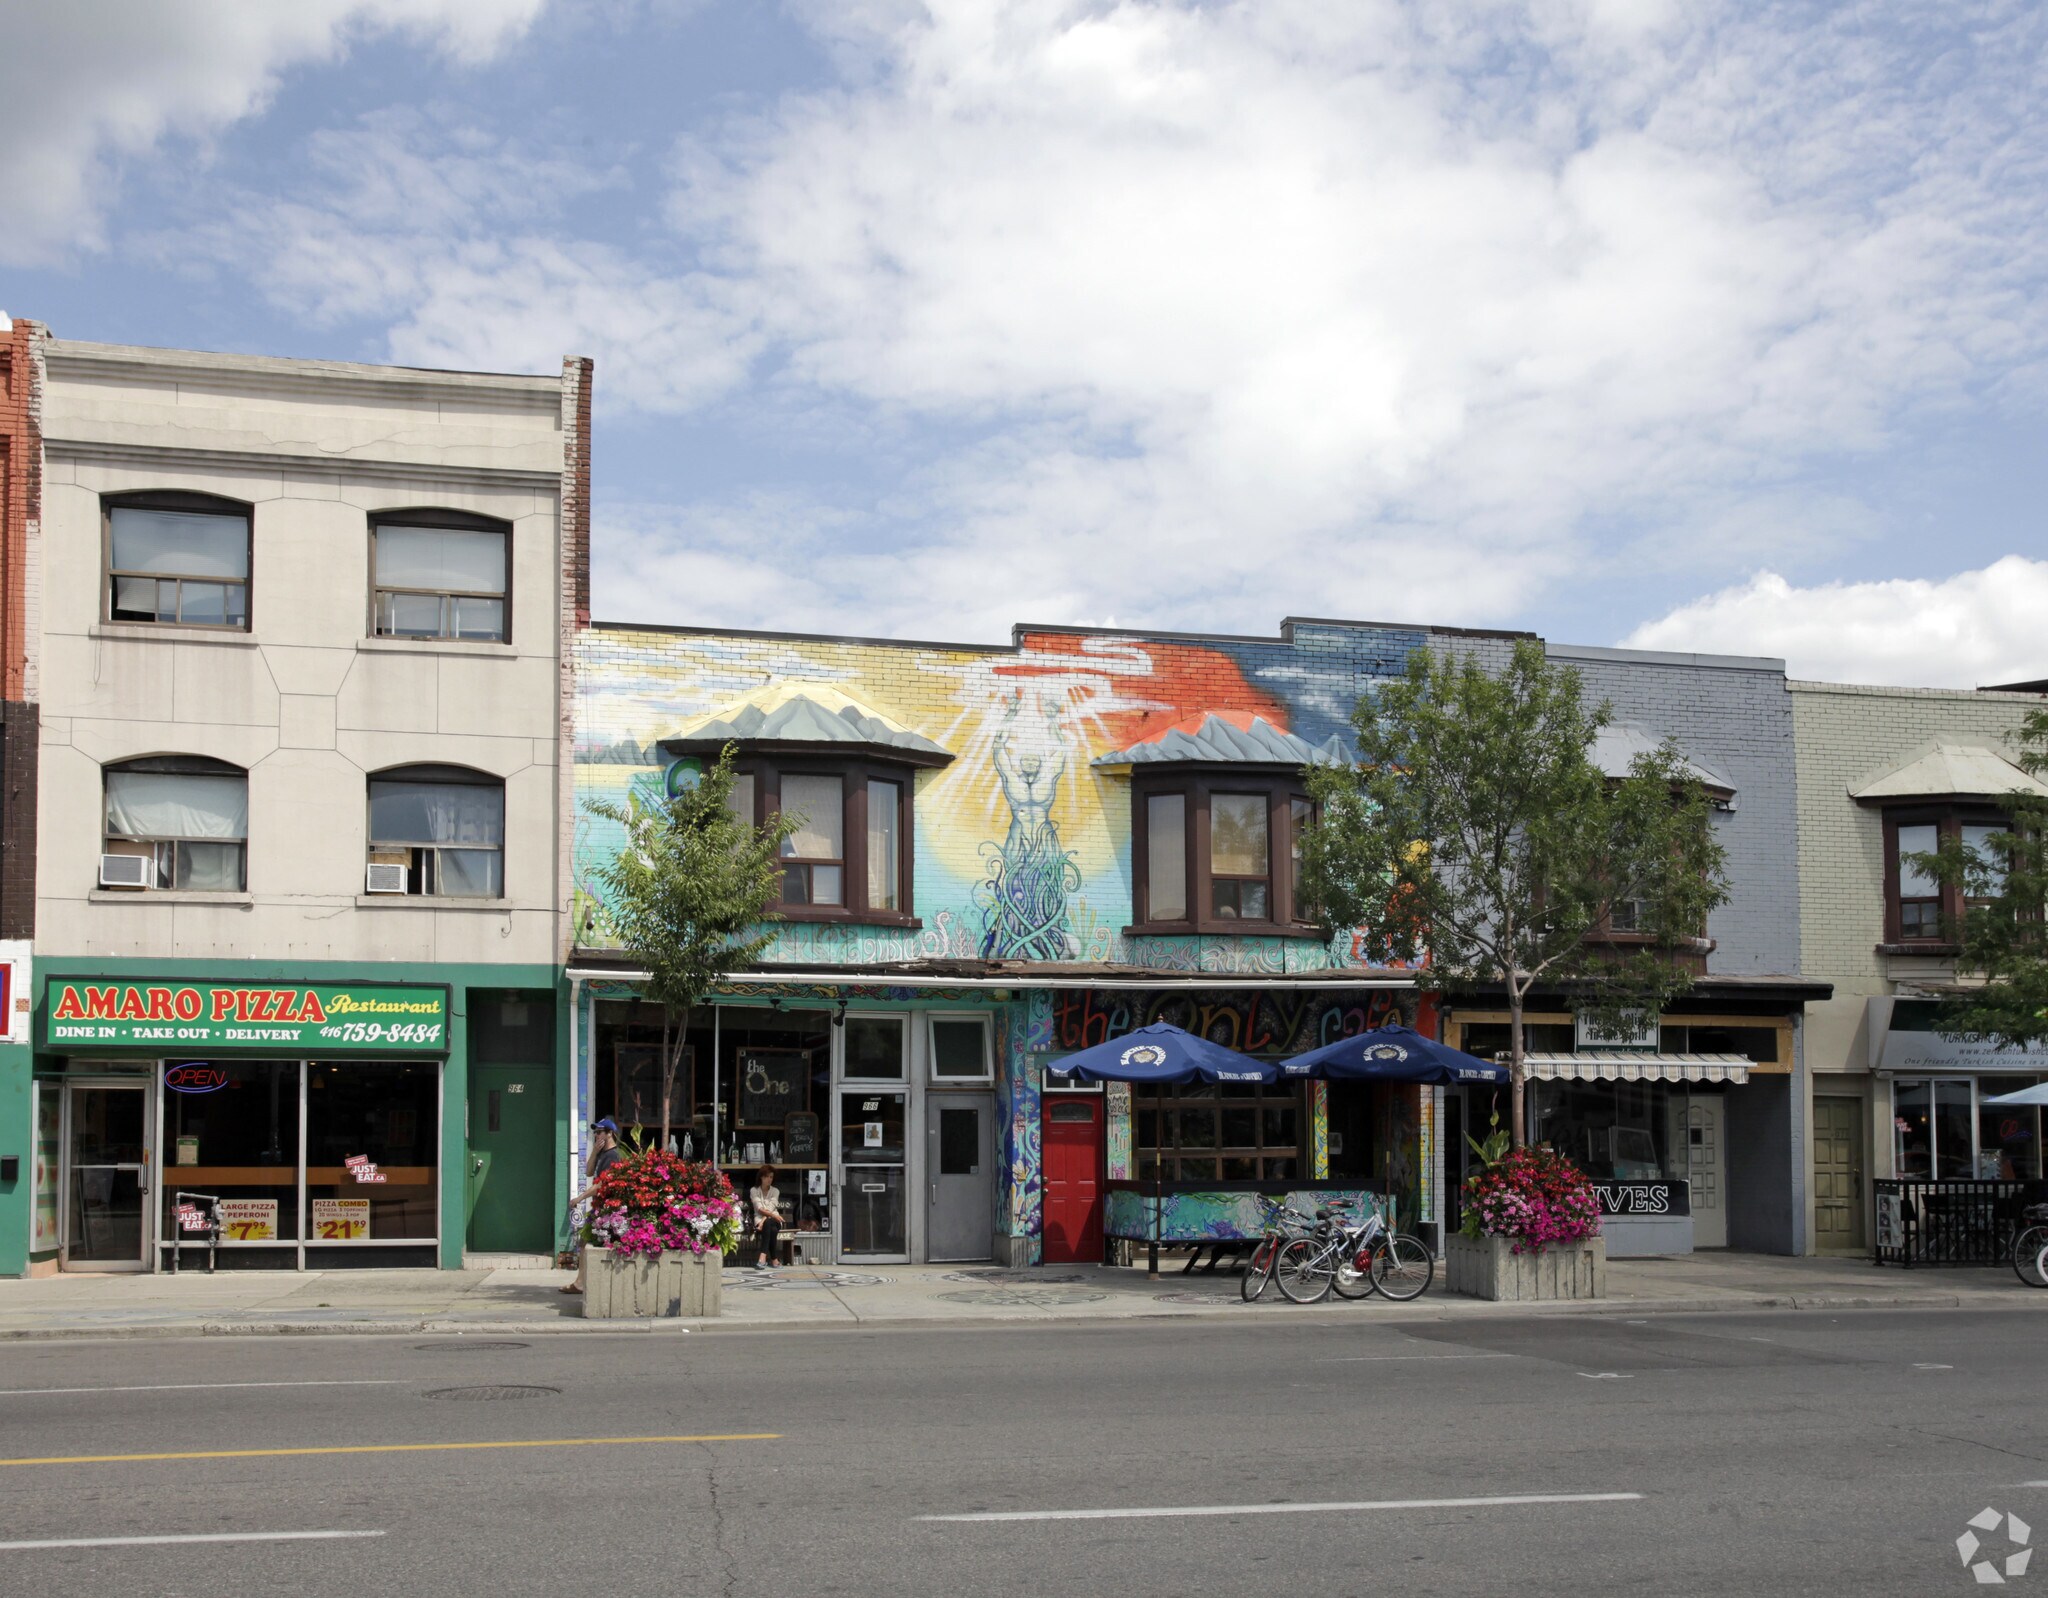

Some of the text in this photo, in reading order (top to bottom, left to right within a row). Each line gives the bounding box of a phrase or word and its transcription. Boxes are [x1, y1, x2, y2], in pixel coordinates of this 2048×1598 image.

[53, 986, 328, 1023] AMARO PIZZA
[324, 994, 442, 1014] Restaurant
[1053, 989, 1131, 1048] the
[55, 1026, 302, 1041] DINE IN TAKE OUT DELIVERY
[319, 1023, 442, 1043] 416 759-8484
[1943, 1031, 1985, 1044] TURKISH
[746, 1059, 765, 1073] the
[1904, 1057, 1921, 1065] One
[1922, 1056, 1960, 1068] friendly
[1962, 1057, 1994, 1066] Turkish
[1996, 1057, 2026, 1066] Cuisine
[167, 1069, 226, 1085] OPEN
[745, 1071, 790, 1095] One
[353, 1165, 376, 1173] JUST
[1592, 1185, 1669, 1213] IVES
[179, 1212, 204, 1221] JUST
